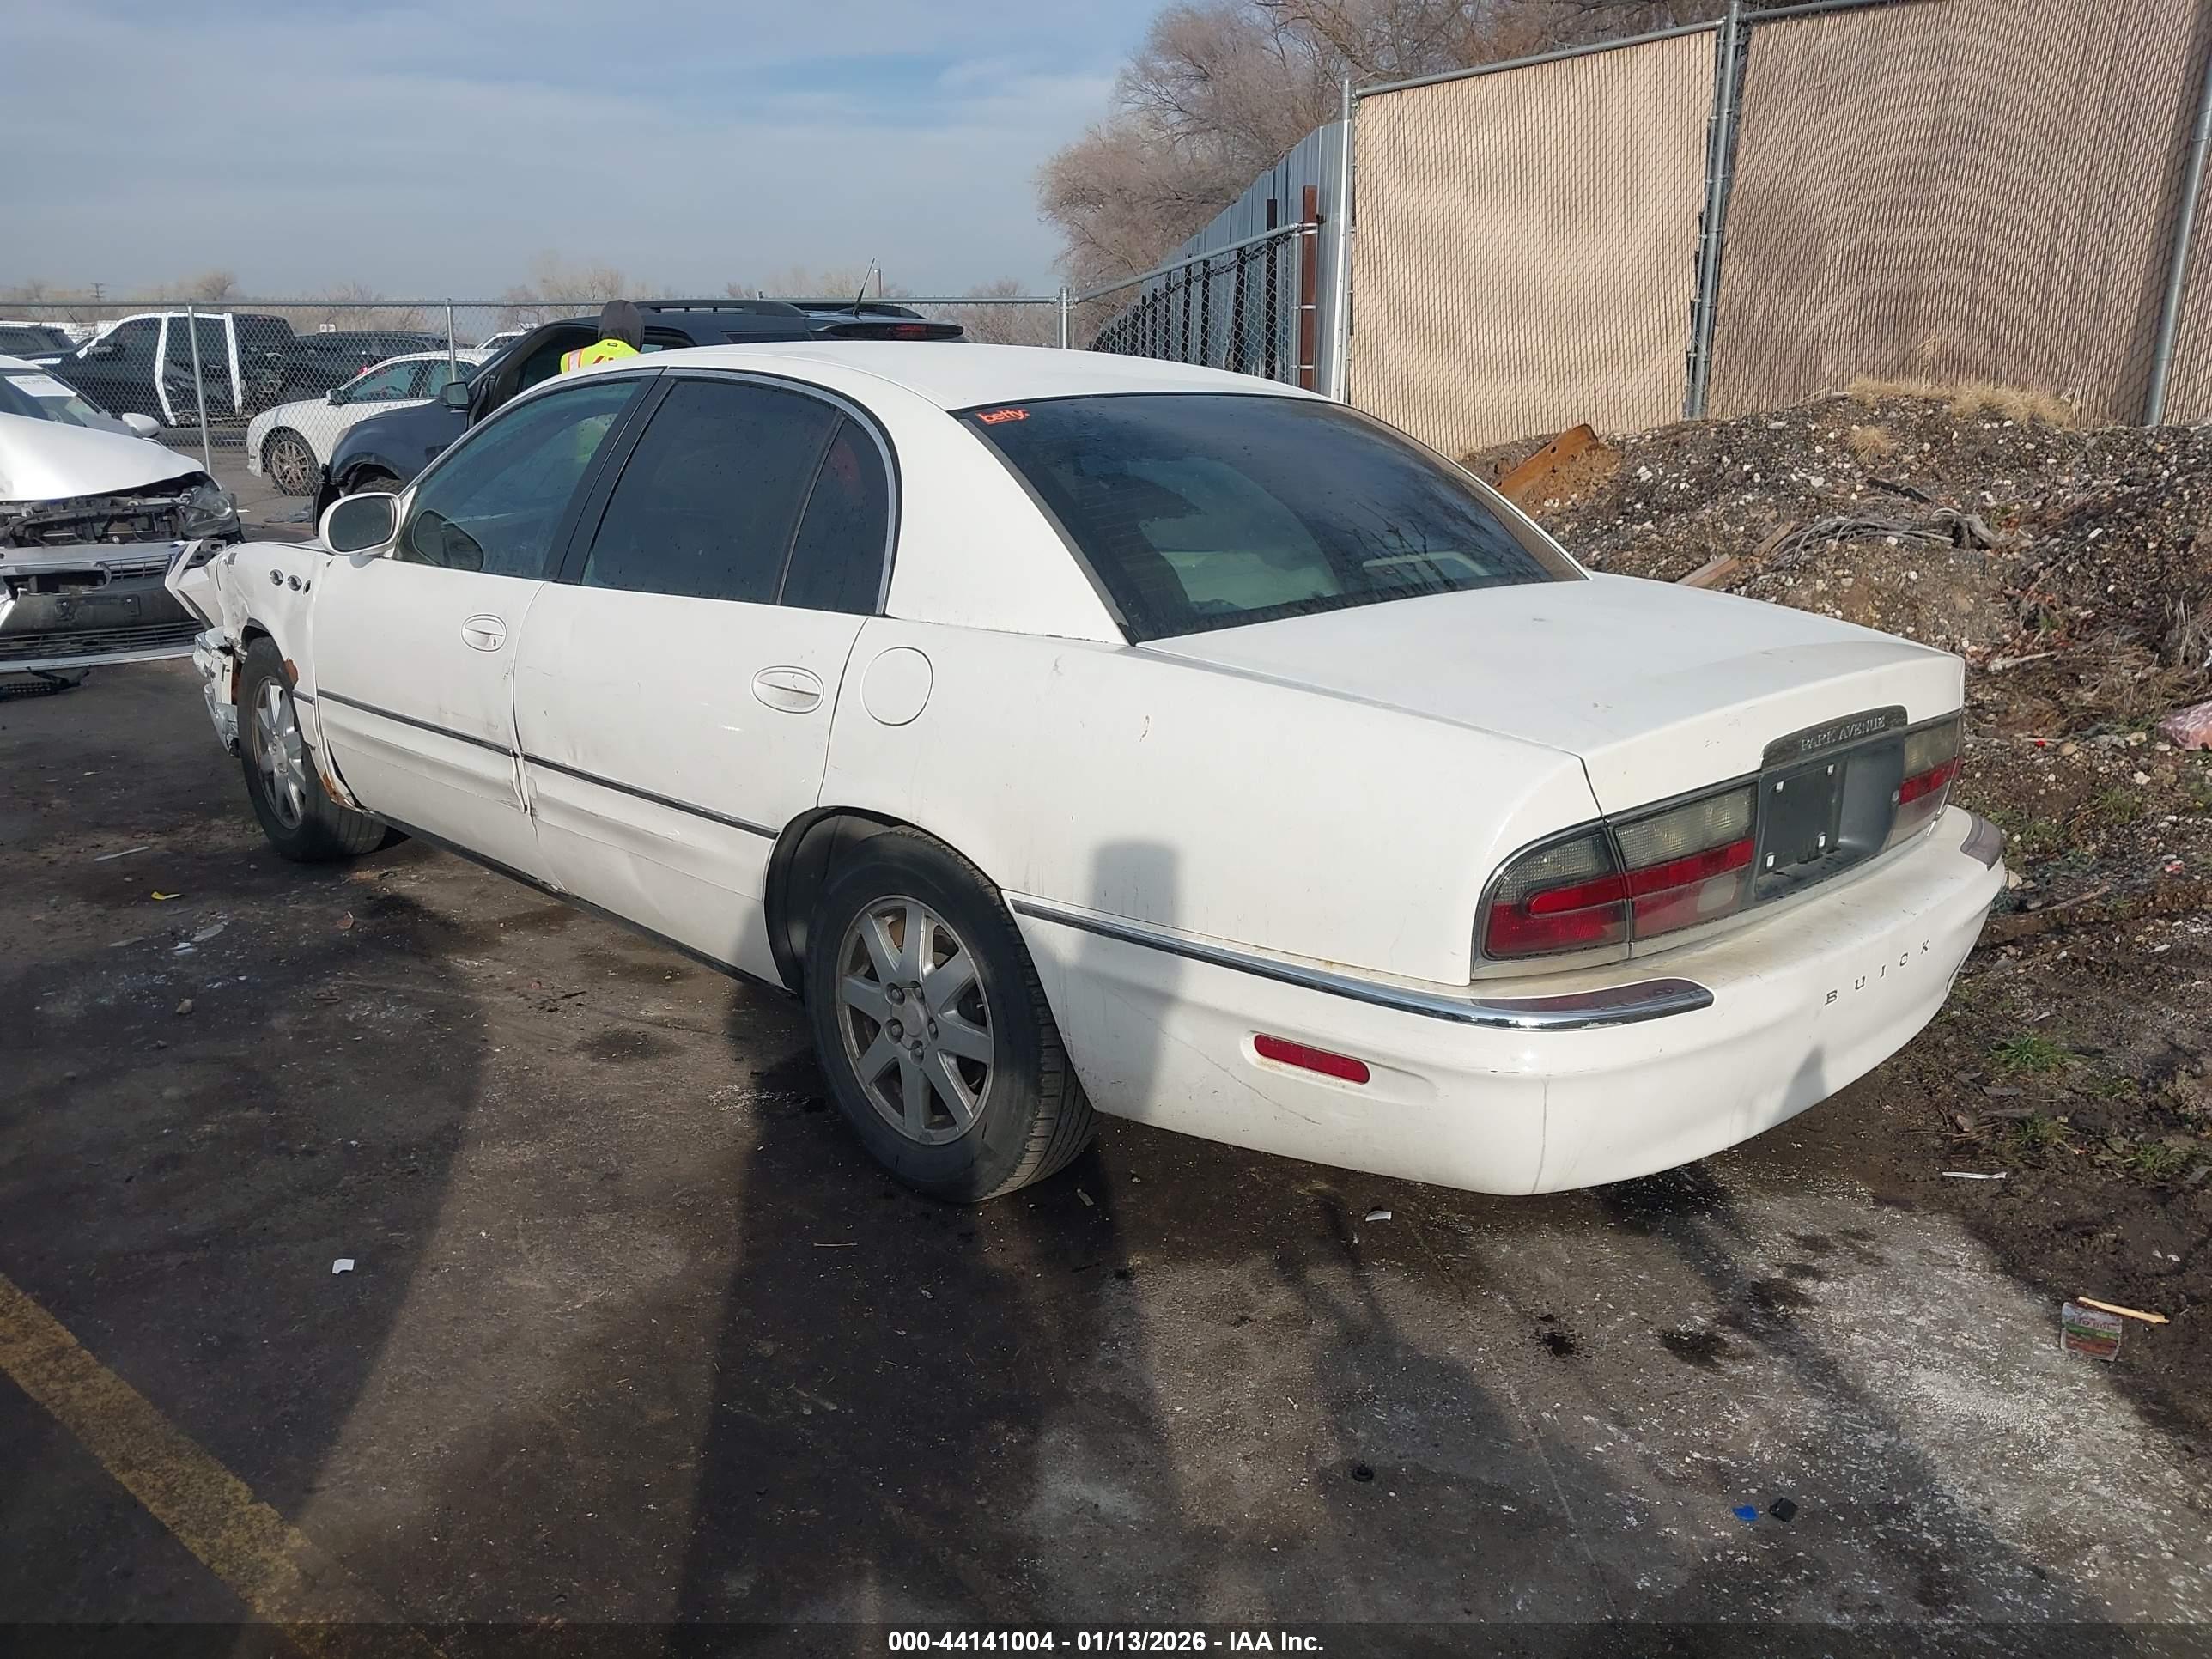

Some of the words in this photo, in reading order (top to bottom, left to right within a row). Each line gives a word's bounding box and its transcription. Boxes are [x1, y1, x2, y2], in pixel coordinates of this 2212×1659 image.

[1801, 731, 1836, 750] PARK
[1839, 716, 1885, 740] AVENUE
[1824, 939, 1930, 1006] BUICK
